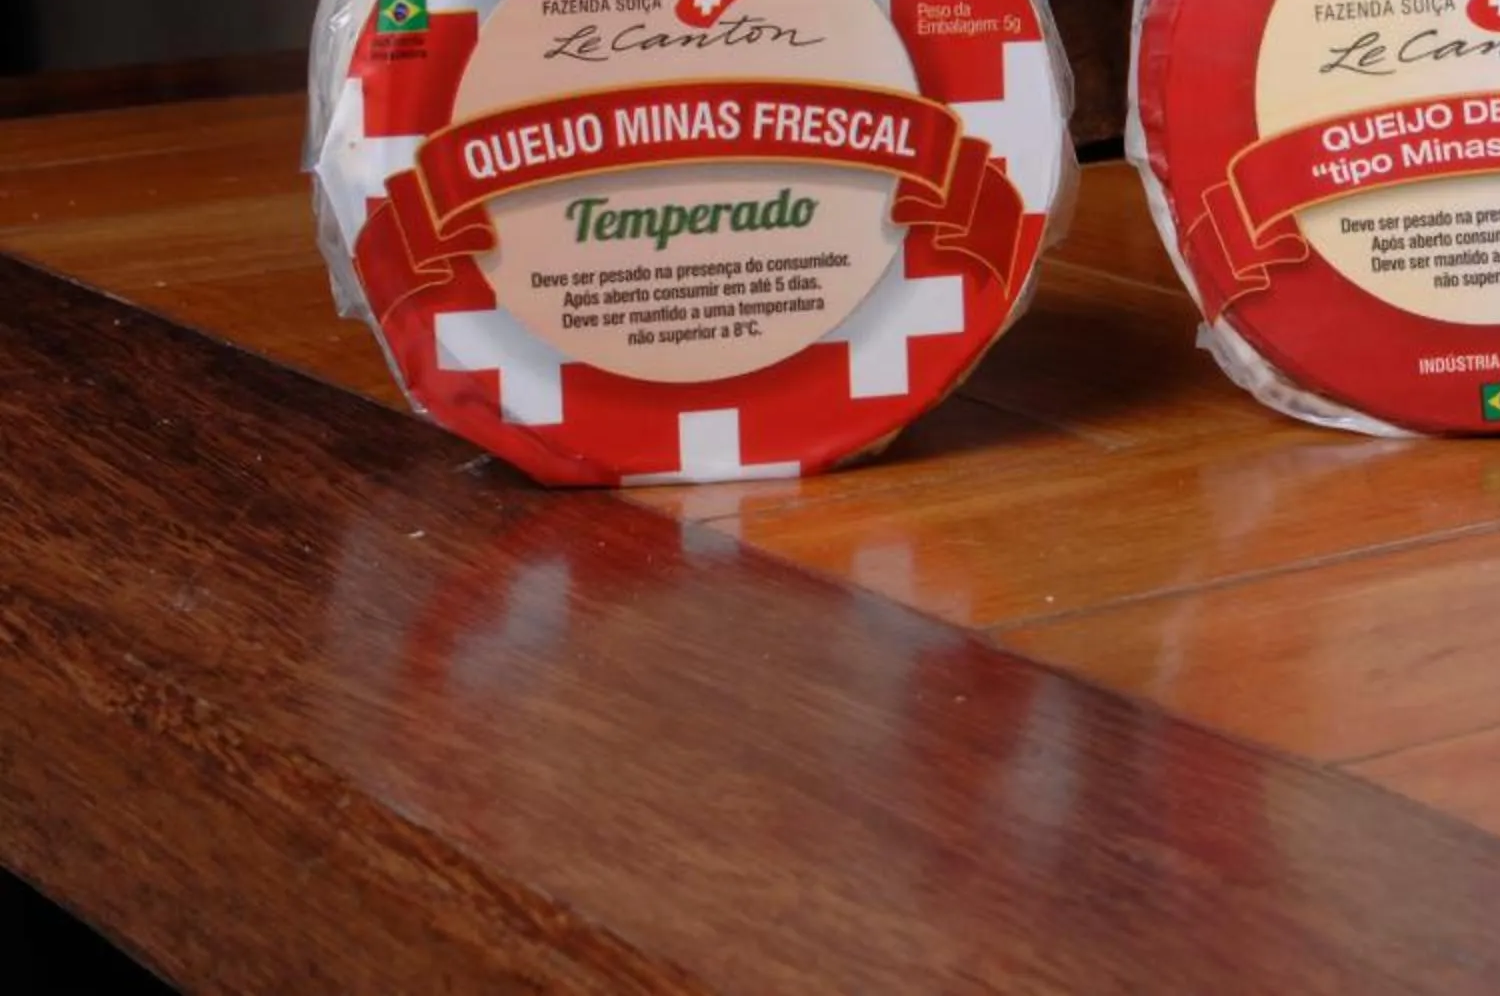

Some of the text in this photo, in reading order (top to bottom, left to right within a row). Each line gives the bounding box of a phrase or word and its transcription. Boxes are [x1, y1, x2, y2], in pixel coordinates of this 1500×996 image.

[917, 1, 971, 18] Peso da
[543, 14, 826, 62] Le Canton
[917, 14, 1020, 36] Embalagem: 5g
[1319, 31, 1397, 76] Le
[463, 100, 917, 180] QUEIJO MINAS FRESCAL
[1321, 103, 1452, 152] QUEIJO
[565, 187, 820, 250] Temperado
[1340, 217, 1375, 234] Deve
[1378, 216, 1400, 230] ser
[1403, 210, 1452, 230] pesado
[1455, 211, 1473, 224] na
[1371, 236, 1405, 254] Após
[1408, 232, 1453, 249] aberto
[531, 253, 851, 288] Deve ser pesado na presença do consumidor.
[1371, 257, 1406, 273] Deve
[1409, 255, 1430, 269] ser
[1433, 250, 1489, 267] mantido
[563, 275, 822, 309] Após aberto consumir em até 5 dias.
[1434, 272, 1460, 288] não
[562, 296, 825, 329] Deve ser mantido a uma temperatura
[627, 330, 655, 345] não
[658, 322, 716, 344] superior
[721, 325, 731, 339] a
[1419, 352, 1500, 375] INDÚSTRIA
